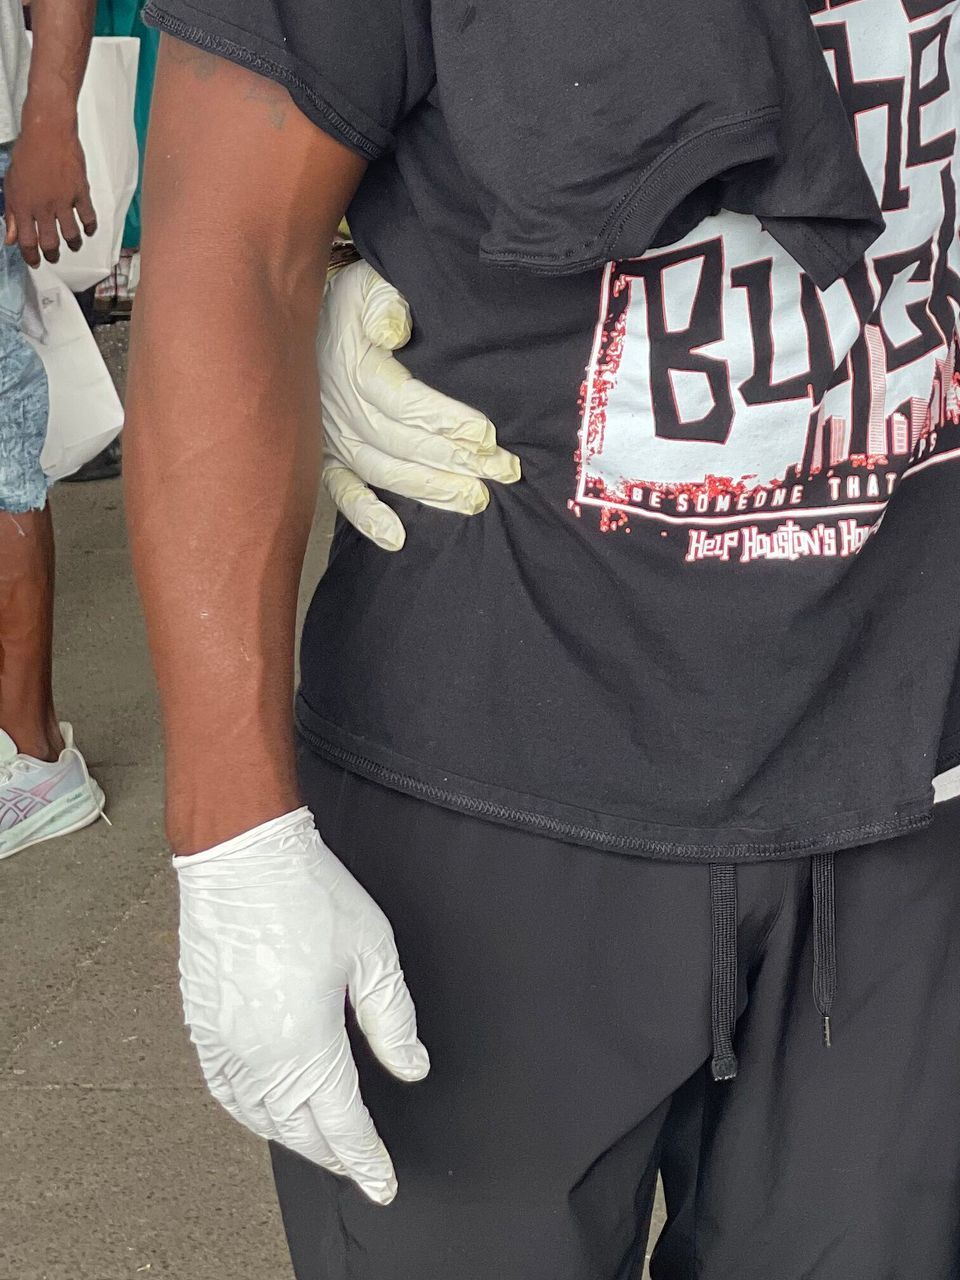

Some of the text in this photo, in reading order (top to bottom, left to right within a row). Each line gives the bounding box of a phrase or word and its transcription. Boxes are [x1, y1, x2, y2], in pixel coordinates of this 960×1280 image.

[630, 486, 663, 509] BE
[676, 484, 804, 514] SOMEONE
[828, 472, 897, 502] THAT
